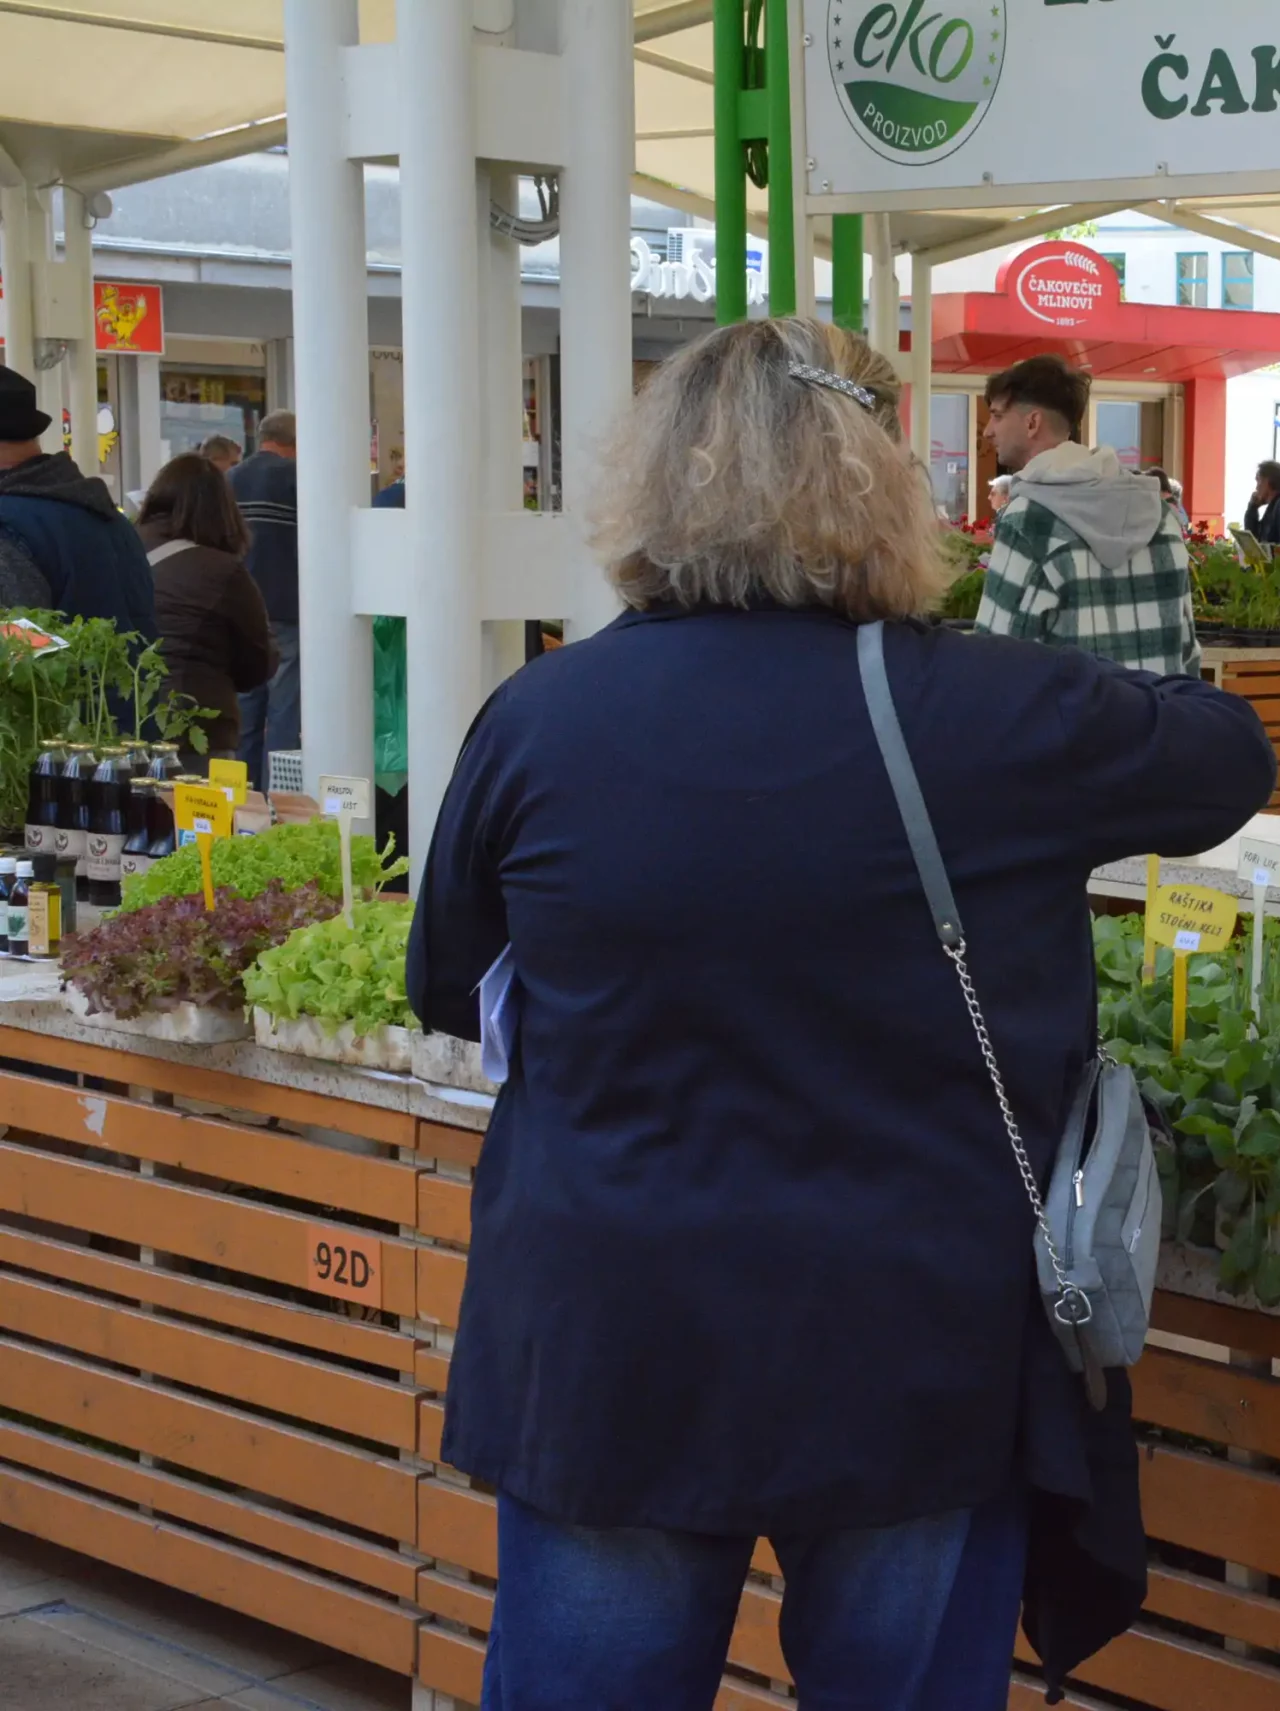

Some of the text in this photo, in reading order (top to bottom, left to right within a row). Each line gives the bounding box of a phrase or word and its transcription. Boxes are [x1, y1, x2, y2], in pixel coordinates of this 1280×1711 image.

[853, 0, 974, 84] eko
[863, 102, 948, 147] PROIZVOD
[1028, 274, 1103, 297] ČAKOVEČKI
[1037, 293, 1093, 310] MLINOVI
[1168, 891, 1214, 914] RAŠTIKA
[316, 1241, 370, 1289] 92D
